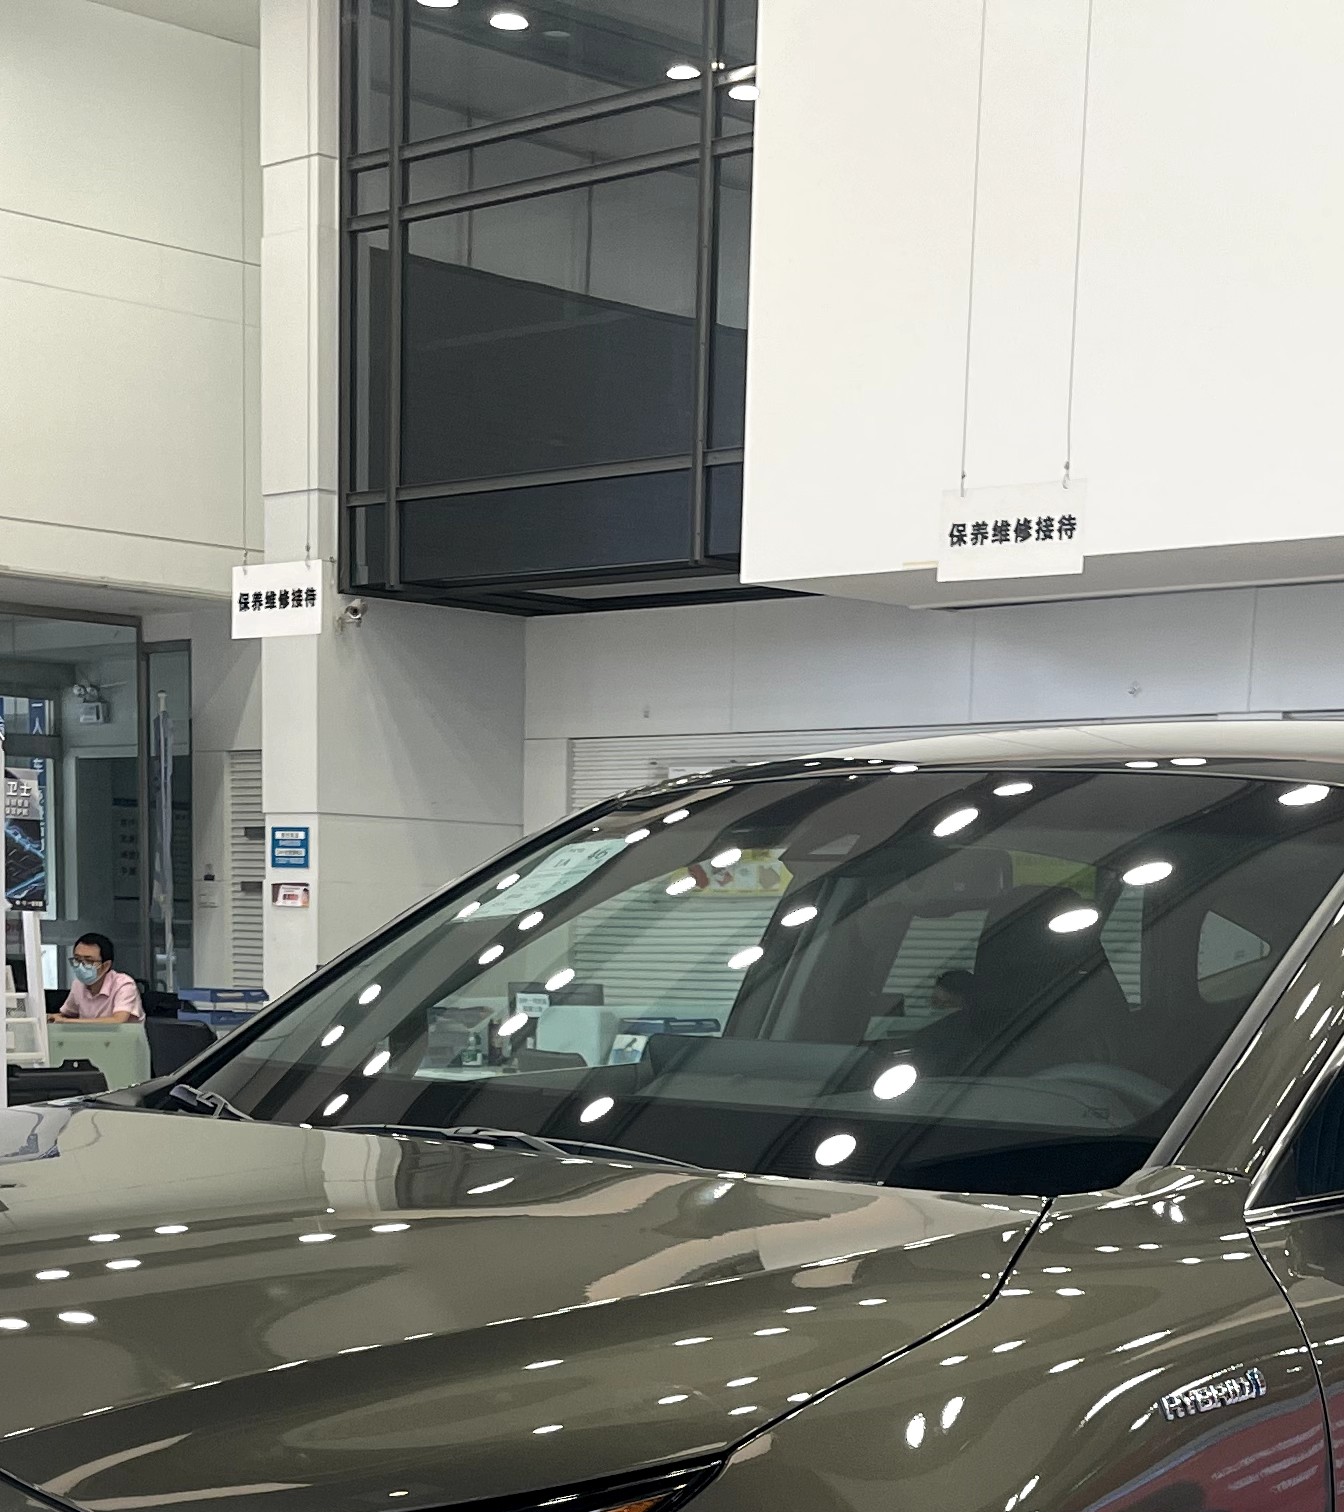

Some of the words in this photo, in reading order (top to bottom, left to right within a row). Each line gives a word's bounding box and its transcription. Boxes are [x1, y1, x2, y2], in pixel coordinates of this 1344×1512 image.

[949, 514, 1077, 547] 保养维修接待
[238, 587, 316, 612] 保养维修接待
[1160, 1369, 1266, 1421] HYBRID
